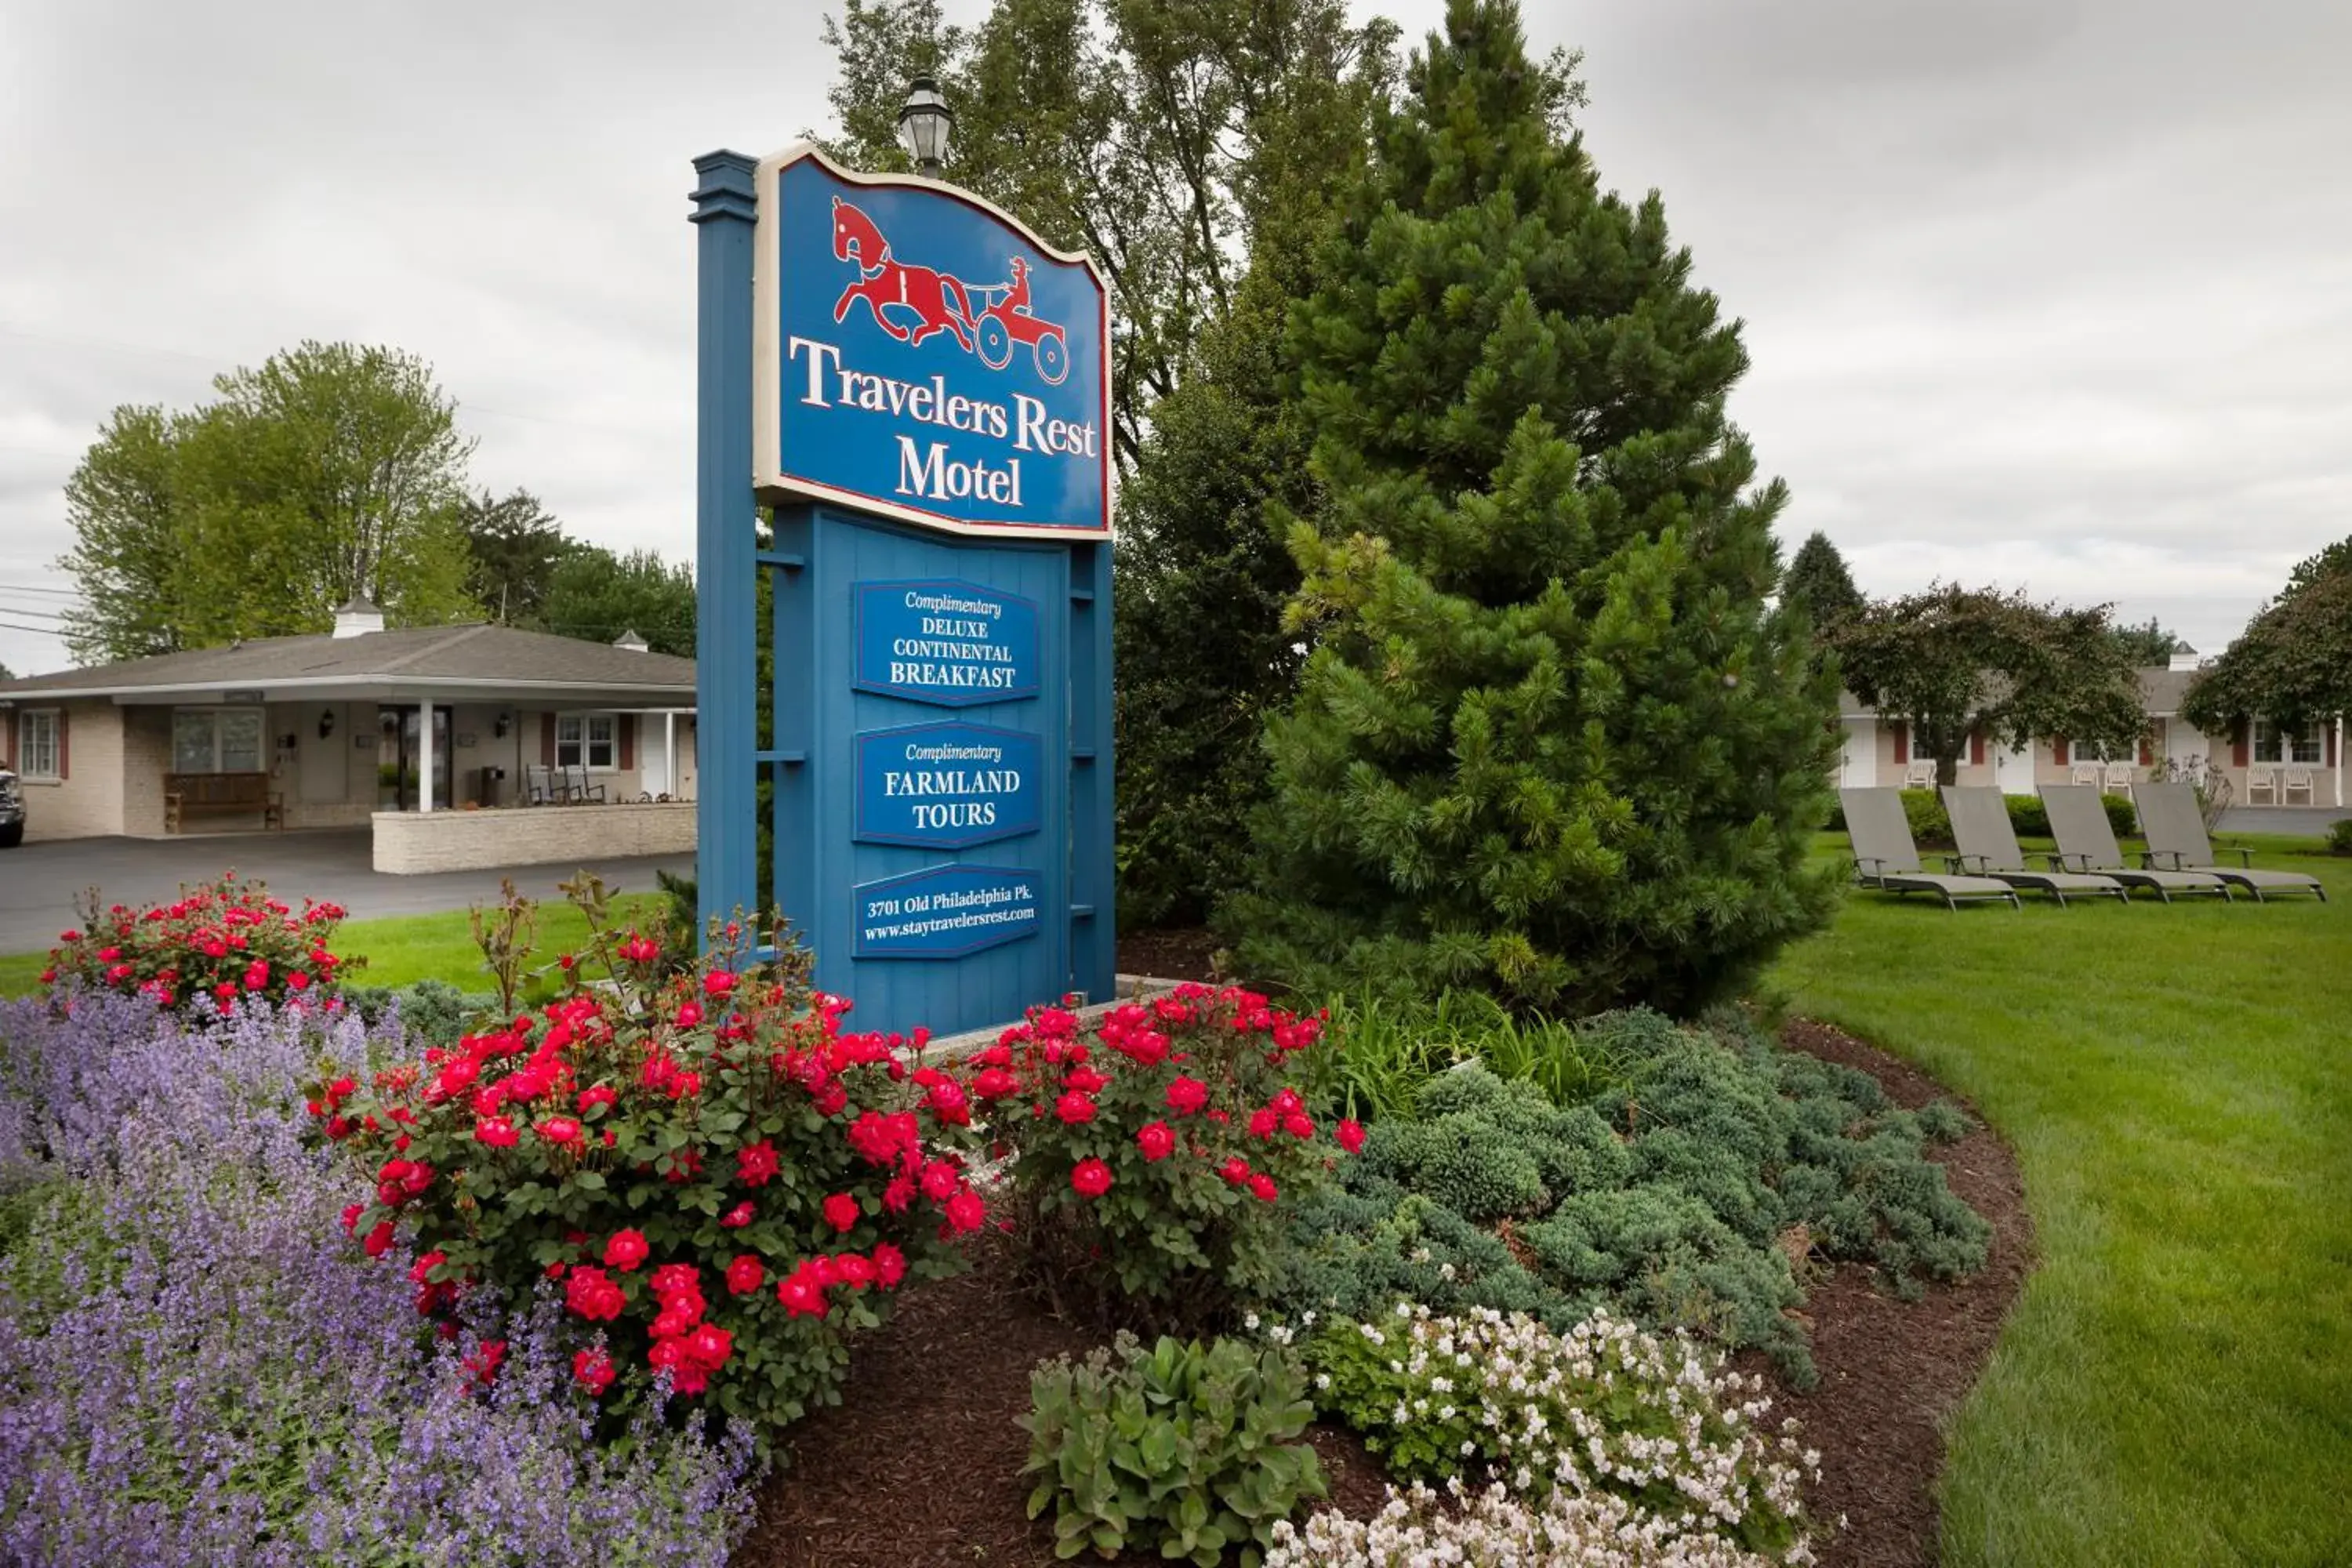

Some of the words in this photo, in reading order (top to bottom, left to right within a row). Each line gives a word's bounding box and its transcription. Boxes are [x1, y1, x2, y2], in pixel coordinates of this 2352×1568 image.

[789, 336, 1007, 438] Travelers
[1012, 393, 1097, 458] Rest
[895, 434, 1022, 506] Motel
[906, 591, 1002, 619] Complimentary
[922, 618, 989, 638] DELUXE
[894, 638, 1012, 662] CONTINENTAL
[890, 661, 1015, 688] BREAKFAST
[906, 743, 1002, 764] Complimentary
[884, 770, 1020, 796] FARMLAND
[913, 802, 996, 828] TOURS
[868, 900, 900, 918] 3701
[905, 895, 929, 913] Old
[932, 887, 1011, 909] Philadelphia
[1015, 884, 1033, 901] Pk.
[865, 907, 1035, 941] www.staytravelersrest.com
